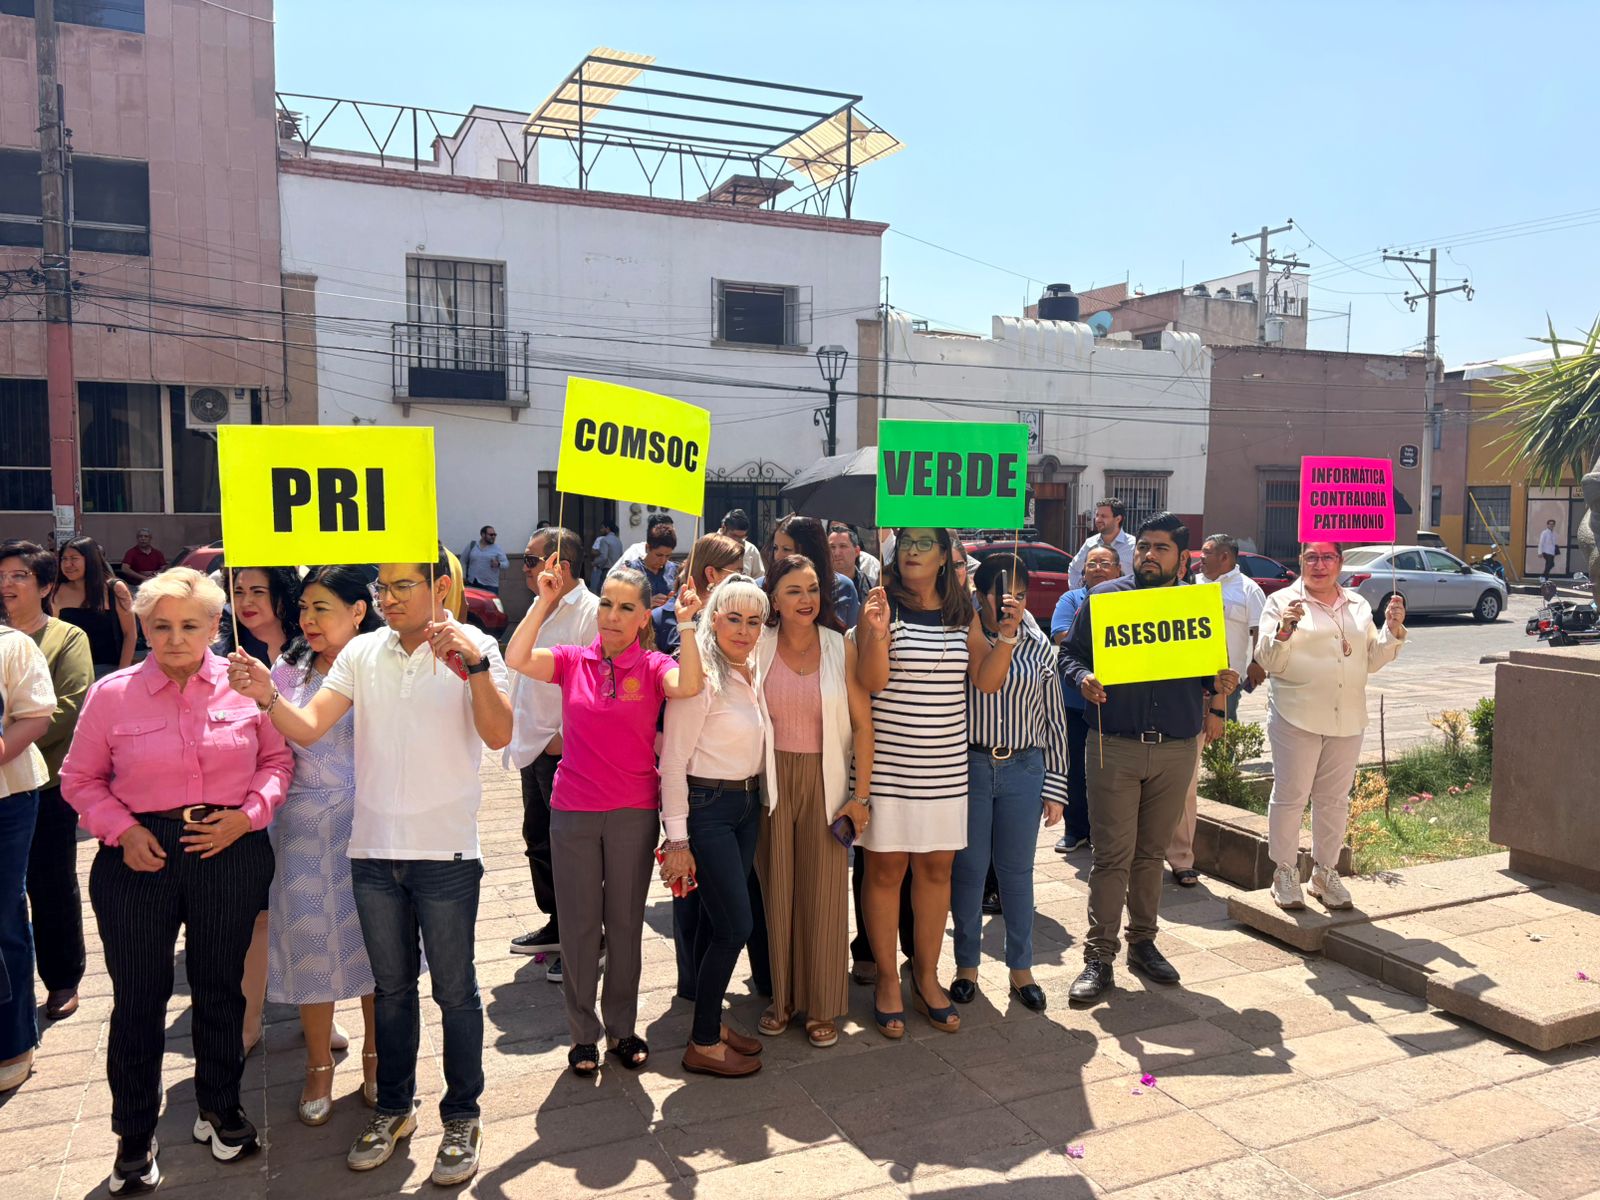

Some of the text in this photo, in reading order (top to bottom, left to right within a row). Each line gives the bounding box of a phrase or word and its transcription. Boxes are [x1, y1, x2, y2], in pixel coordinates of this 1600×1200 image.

[575, 418, 698, 472] COMSOC
[883, 451, 1017, 497] VERDE
[1312, 466, 1385, 484] INFORMÁTICA
[272, 468, 385, 532] PRI
[1311, 489, 1386, 506] CONTRALORÍA
[1314, 514, 1383, 529] PATRIMONIO
[1105, 617, 1211, 647] ASESORES
